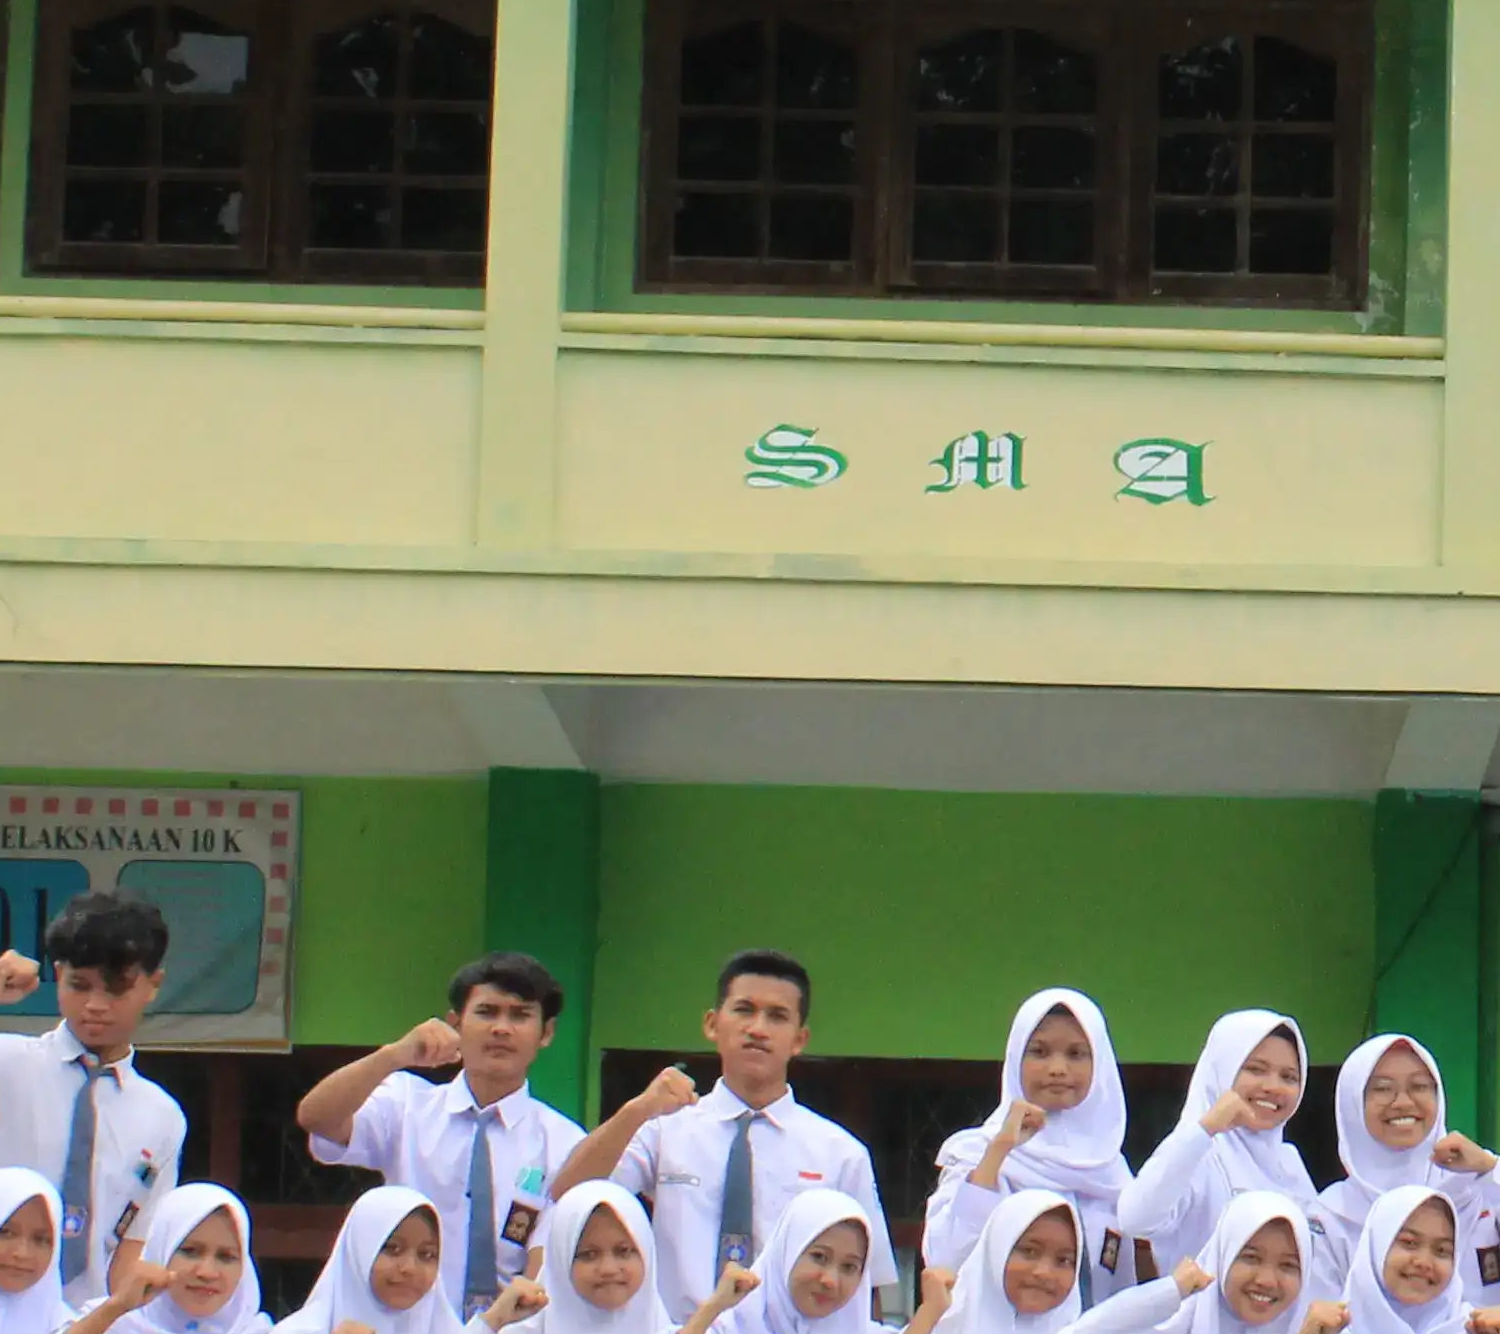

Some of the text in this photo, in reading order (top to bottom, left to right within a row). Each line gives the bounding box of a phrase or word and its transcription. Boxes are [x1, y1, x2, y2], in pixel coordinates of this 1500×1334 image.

[745, 424, 1216, 506] SMA
[192, 828, 215, 854] 10
[223, 829, 243, 854] K
